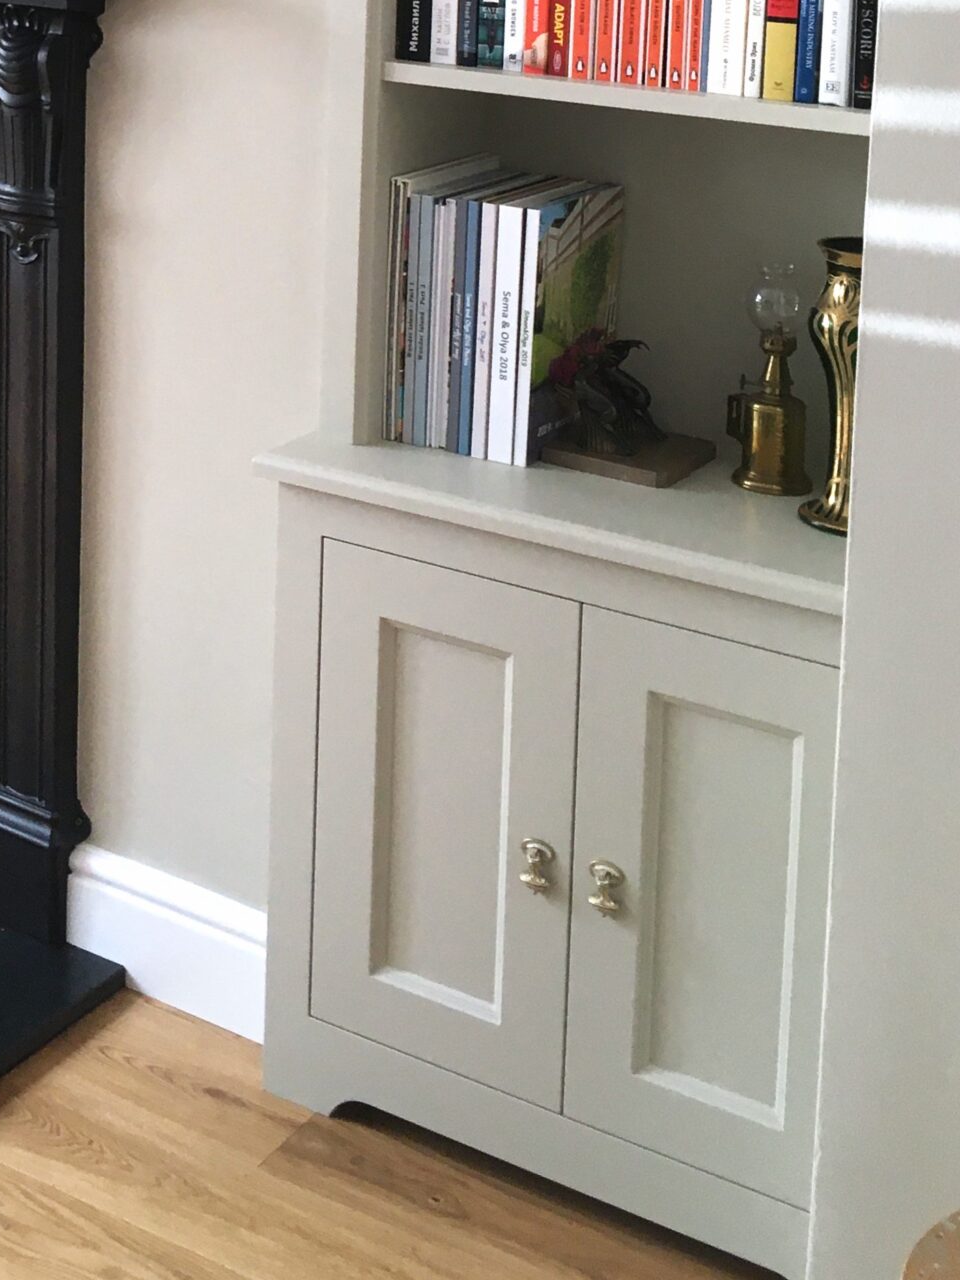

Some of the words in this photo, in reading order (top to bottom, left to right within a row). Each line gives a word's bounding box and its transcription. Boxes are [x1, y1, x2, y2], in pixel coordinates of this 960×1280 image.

[409, 0, 420, 53] Михаил
[532, 4, 540, 32] HARFORD
[553, 3, 565, 47] ADAPT
[808, 4, 816, 32] MINING
[830, 10, 838, 27] ROY
[860, 10, 875, 59] SCORE
[750, 41, 759, 57] Эрих
[805, 33, 815, 70] INDUSTRY
[748, 59, 757, 82] Фромм
[501, 291, 512, 318] Sema
[501, 320, 510, 329] &
[499, 332, 510, 354] Olya
[498, 356, 509, 381] 2018
[520, 350, 528, 367] 2019
